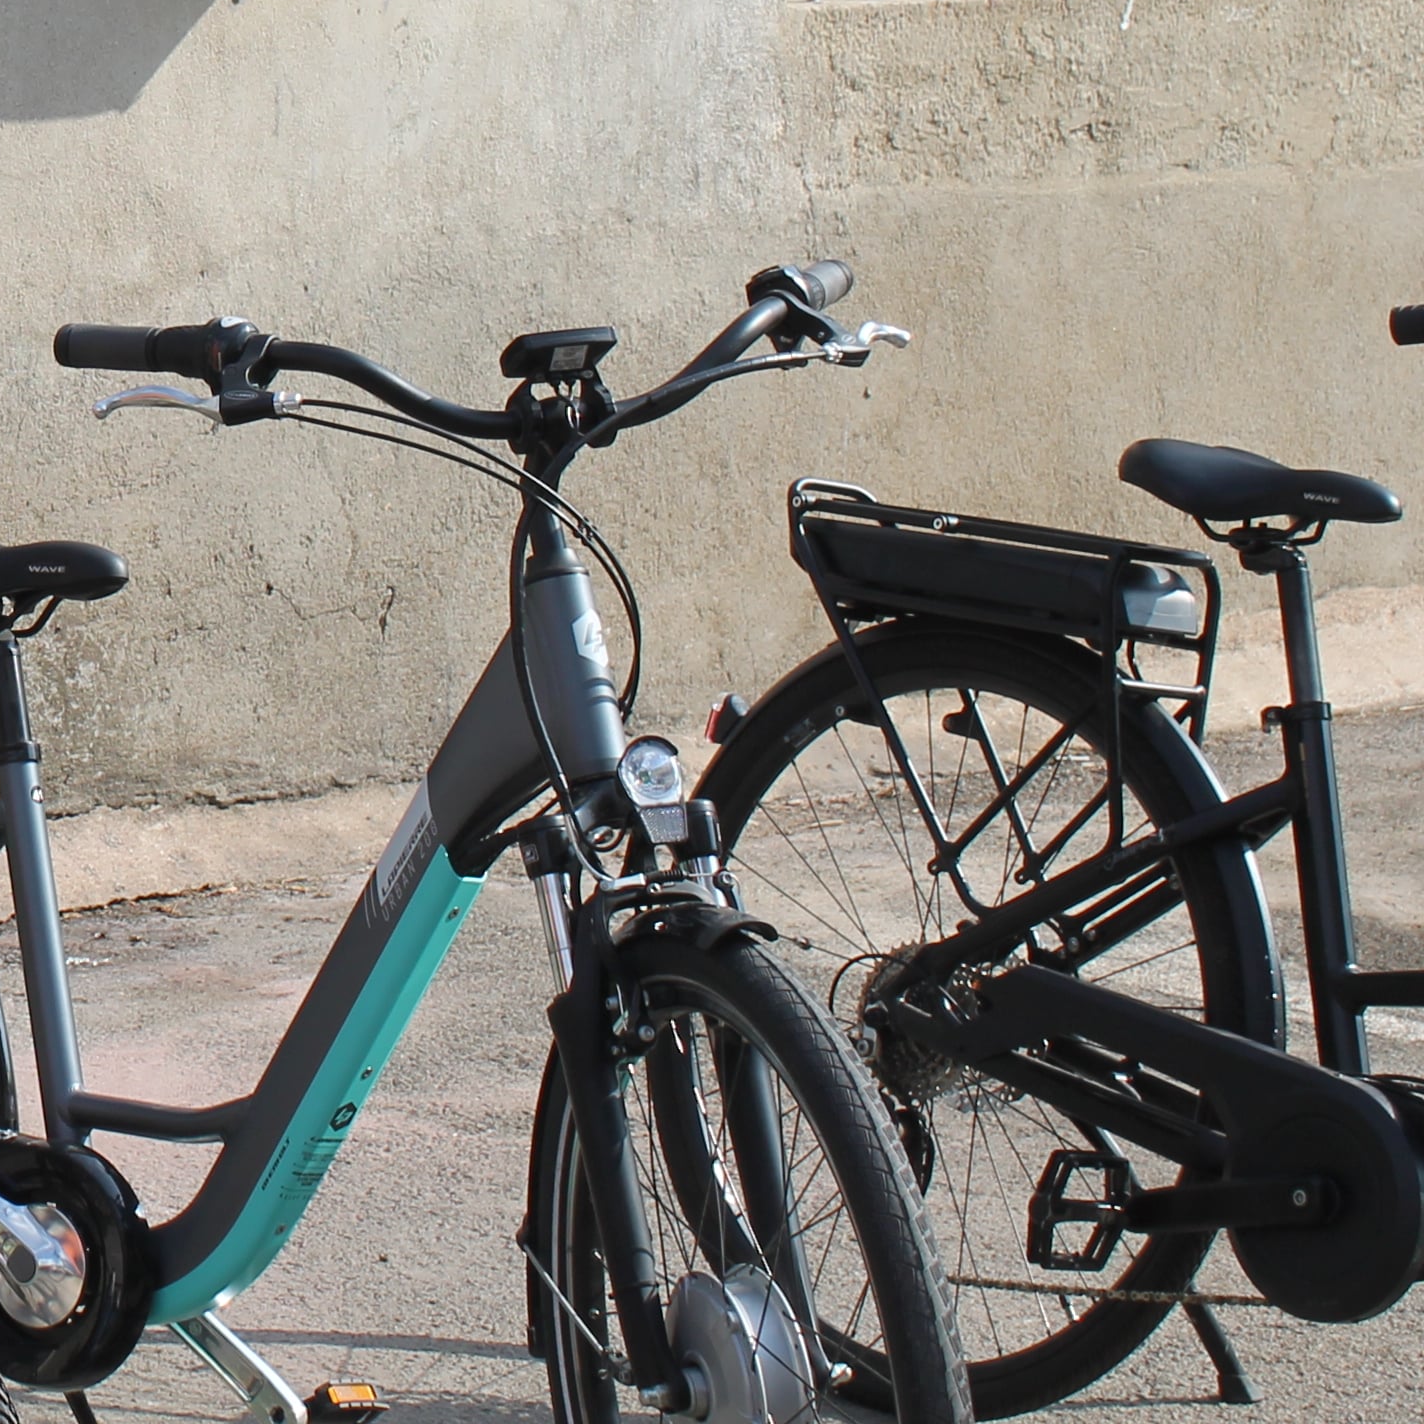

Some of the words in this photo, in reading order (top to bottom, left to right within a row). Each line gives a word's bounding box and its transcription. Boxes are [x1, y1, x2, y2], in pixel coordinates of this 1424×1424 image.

[1303, 492, 1341, 505] WAVE
[28, 564, 66, 574] WAVE
[381, 811, 429, 897] LAPIERRE
[381, 864, 417, 922] URBAN
